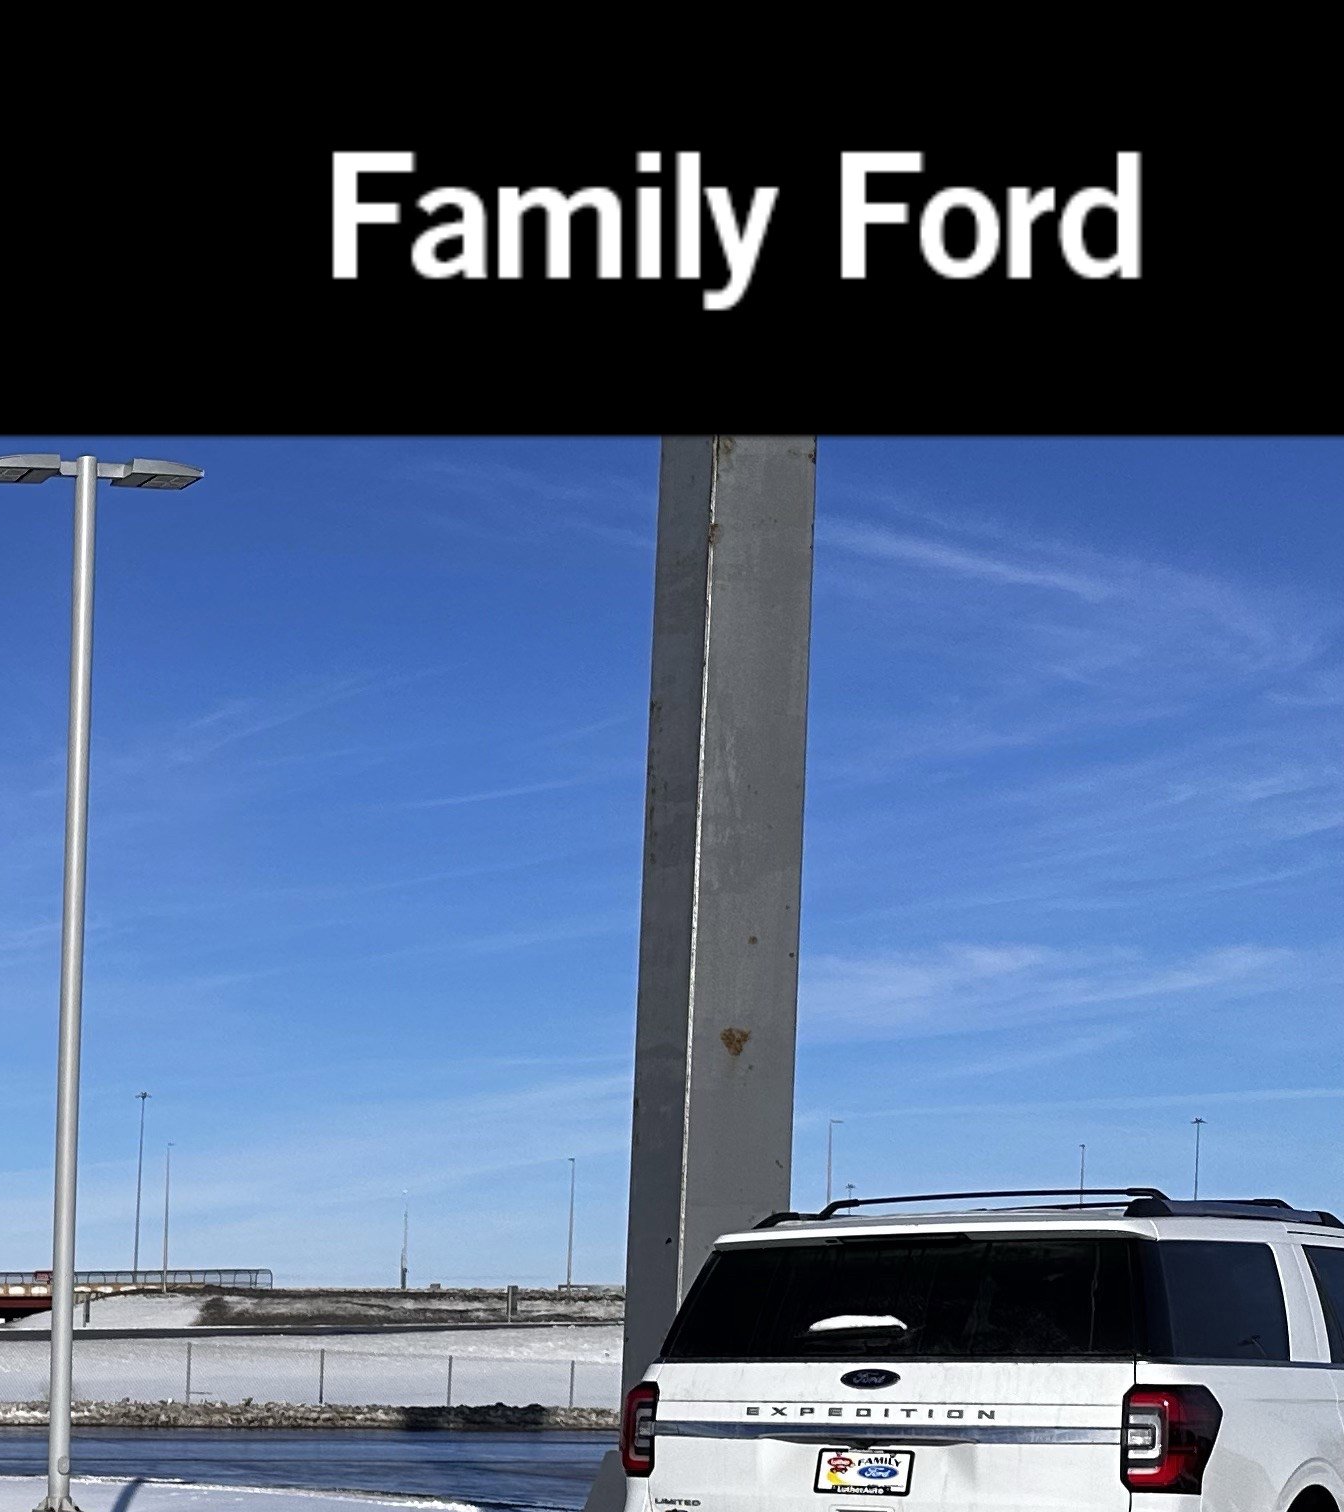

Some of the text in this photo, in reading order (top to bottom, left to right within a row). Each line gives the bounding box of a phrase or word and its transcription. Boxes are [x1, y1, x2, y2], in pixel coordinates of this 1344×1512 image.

[852, 1371, 886, 1384] Ford
[746, 1406, 996, 1420] EXPEDITION
[857, 1456, 902, 1468] FAMILY
[864, 1467, 891, 1478] Ford
[654, 1497, 701, 1506] LIMITED
